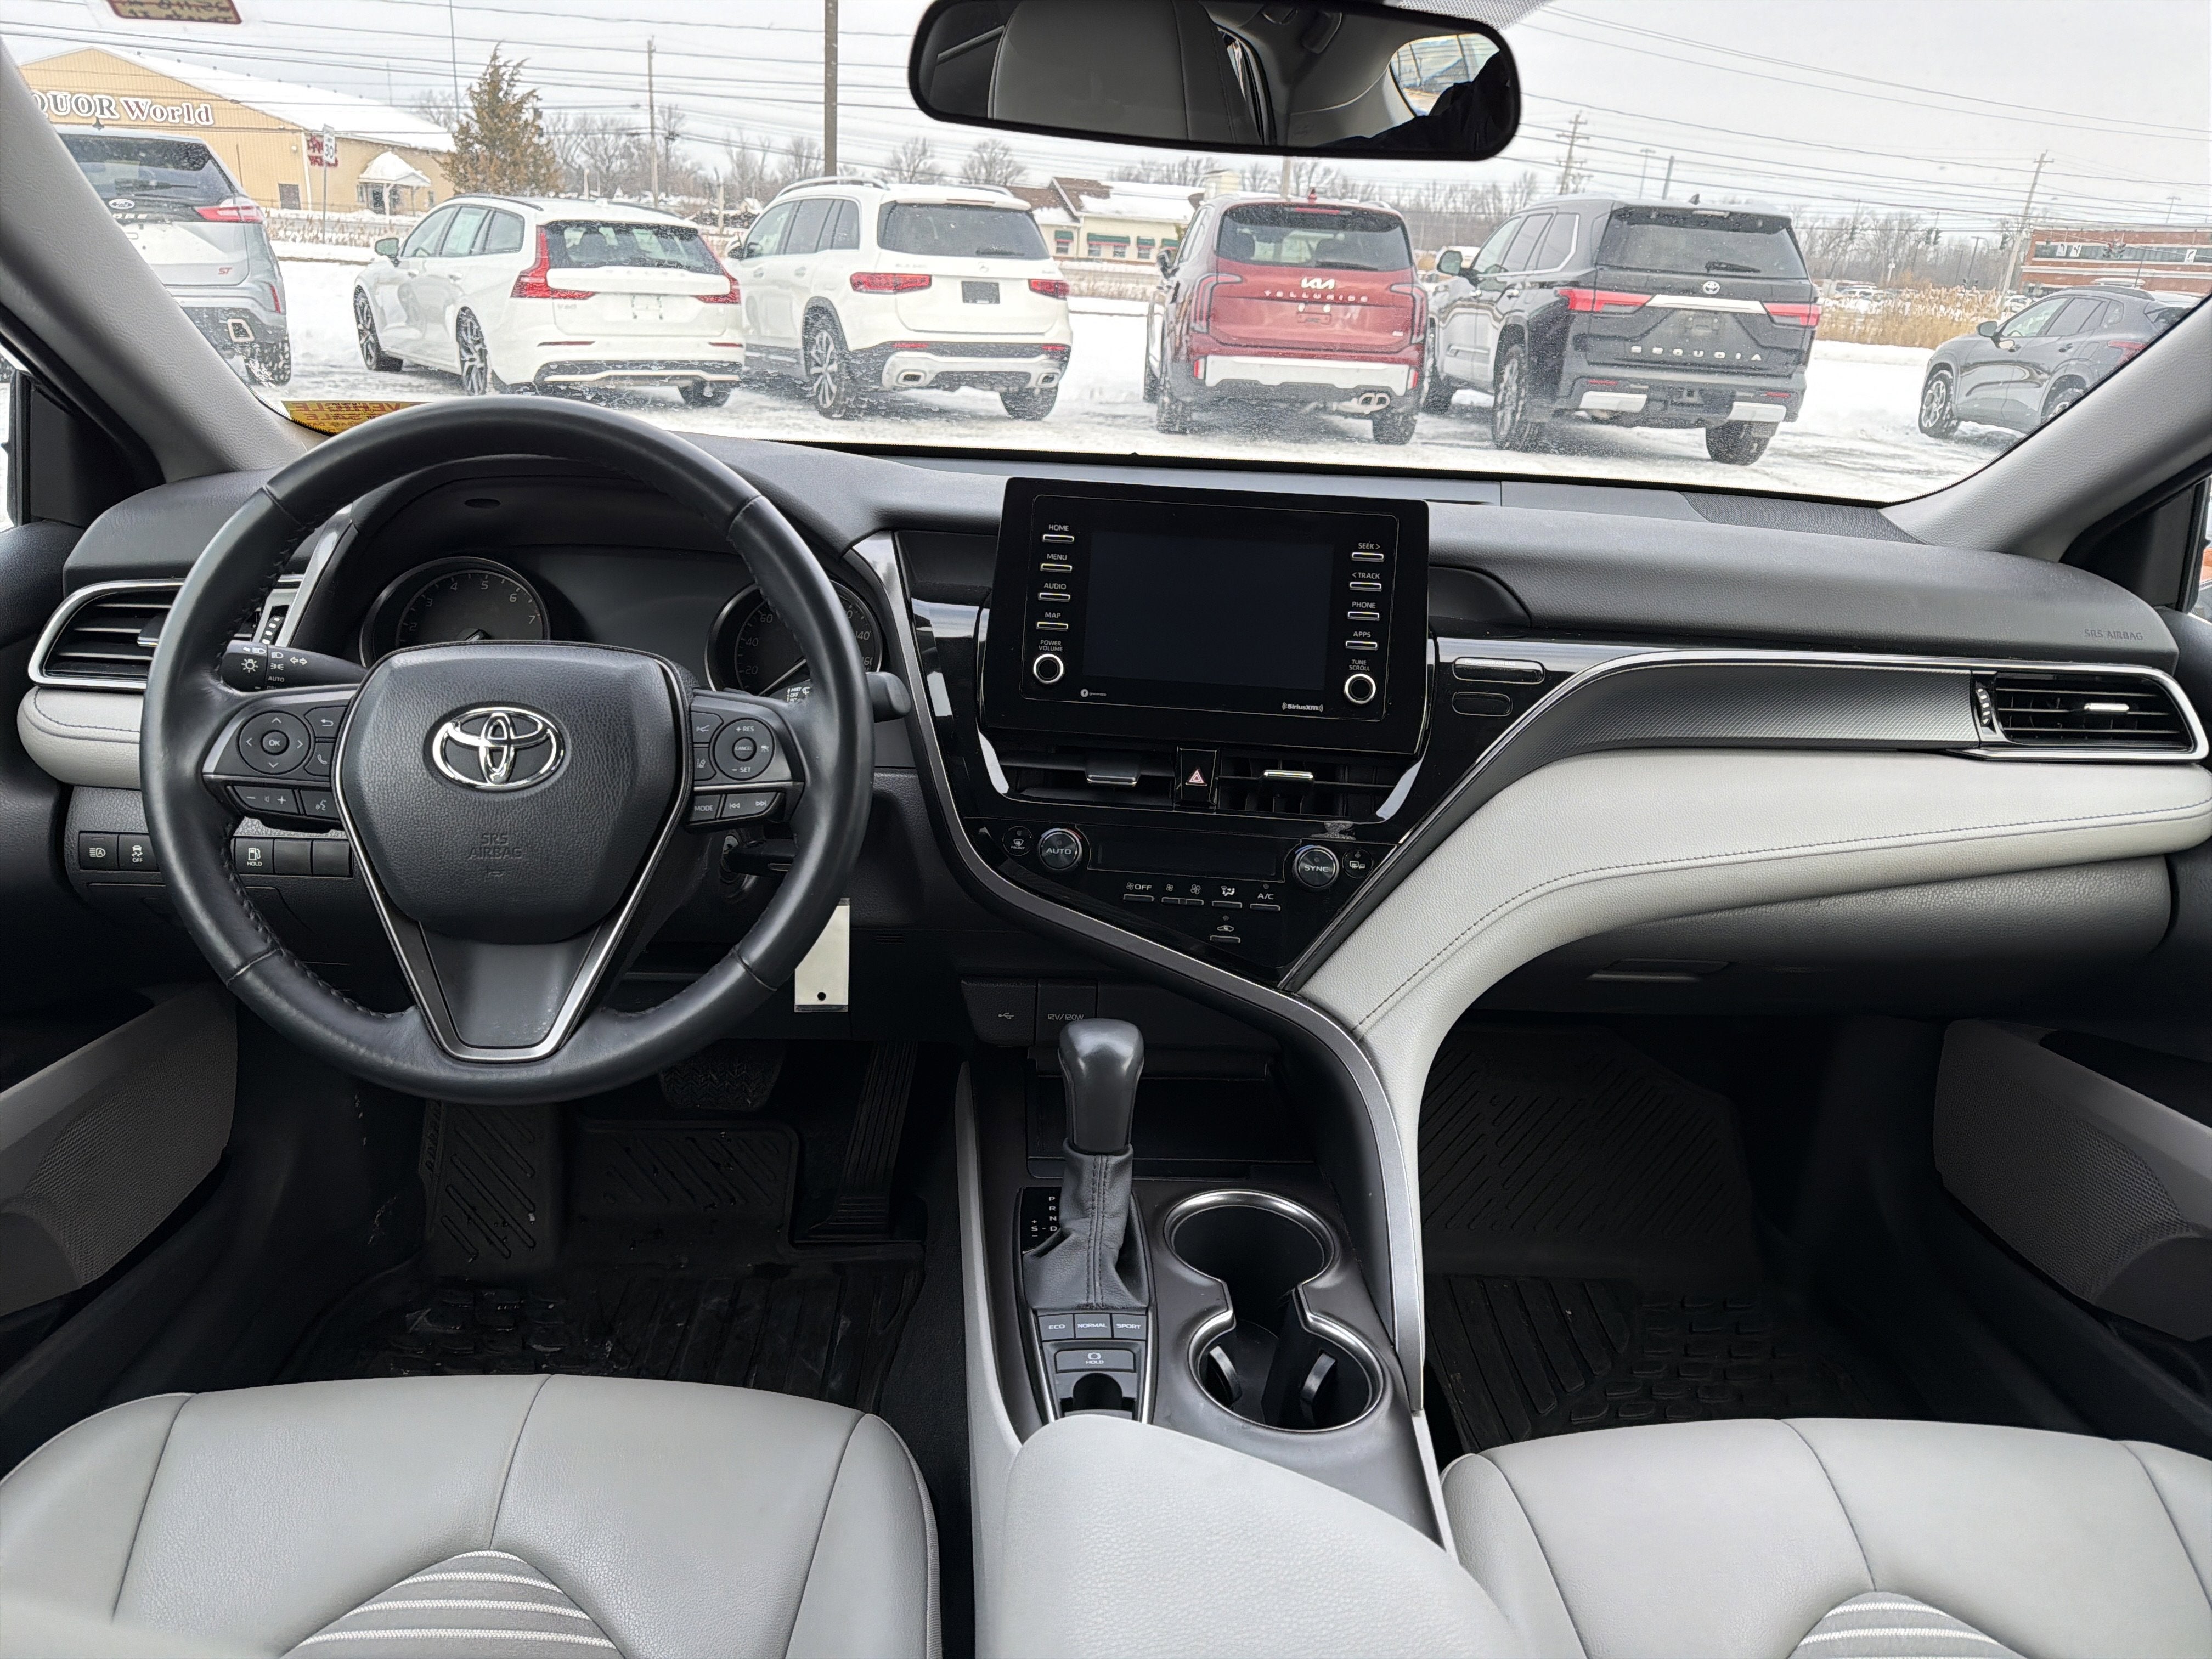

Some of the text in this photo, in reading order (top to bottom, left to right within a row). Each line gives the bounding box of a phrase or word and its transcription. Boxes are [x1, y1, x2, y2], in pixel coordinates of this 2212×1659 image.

[120, 97, 214, 126] World
[325, 144, 334, 159] 30
[450, 582, 458, 591] 4
[481, 580, 488, 590] 5
[426, 598, 433, 607] 3
[510, 594, 517, 602] 6
[528, 615, 535, 624] 7
[760, 614, 773, 623] 60
[409, 622, 417, 631] 2
[2085, 629, 2143, 640] SRS AIRBAG
[746, 638, 759, 646] 40
[746, 666, 758, 674] 20
[482, 833, 509, 845] SRS
